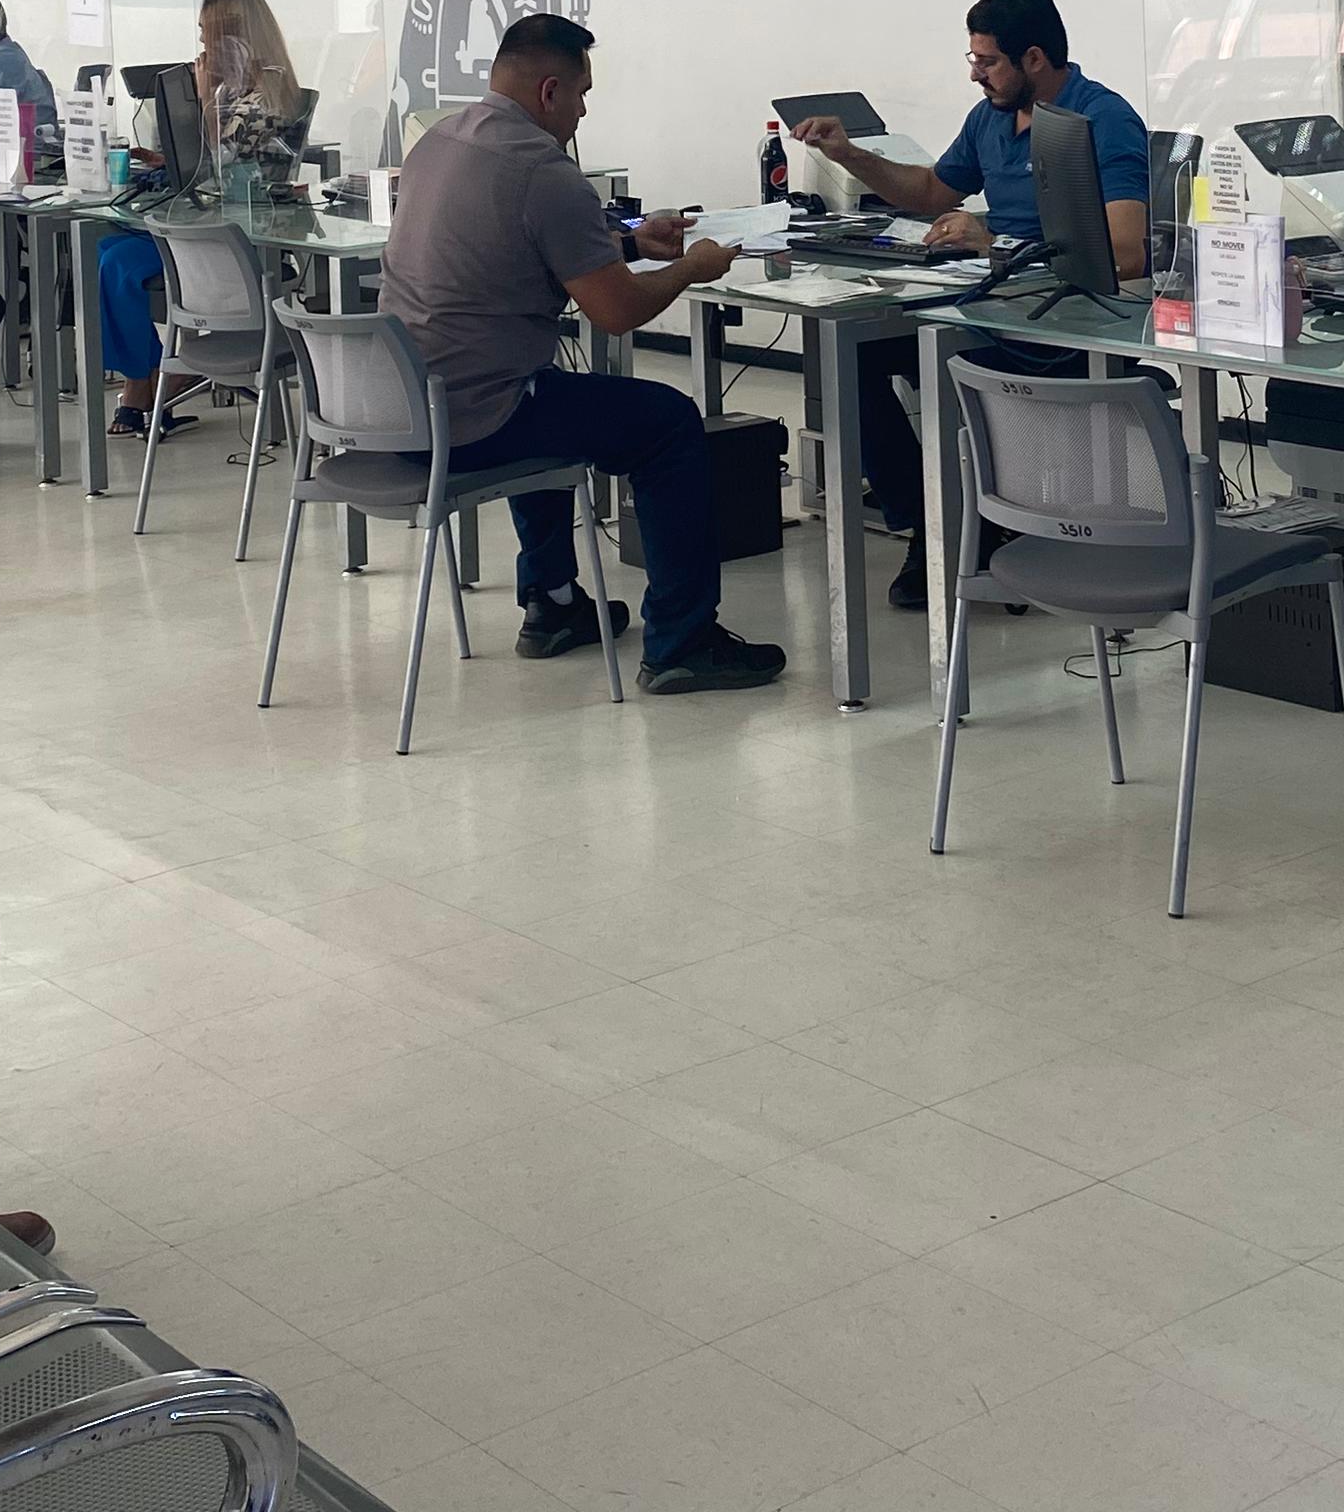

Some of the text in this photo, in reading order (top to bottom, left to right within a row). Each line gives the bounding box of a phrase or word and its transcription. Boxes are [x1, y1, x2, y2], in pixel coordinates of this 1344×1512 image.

[1211, 239, 1245, 251] NO MOVER
[1000, 381, 1033, 395] 3510
[1058, 522, 1092, 537] 3510
